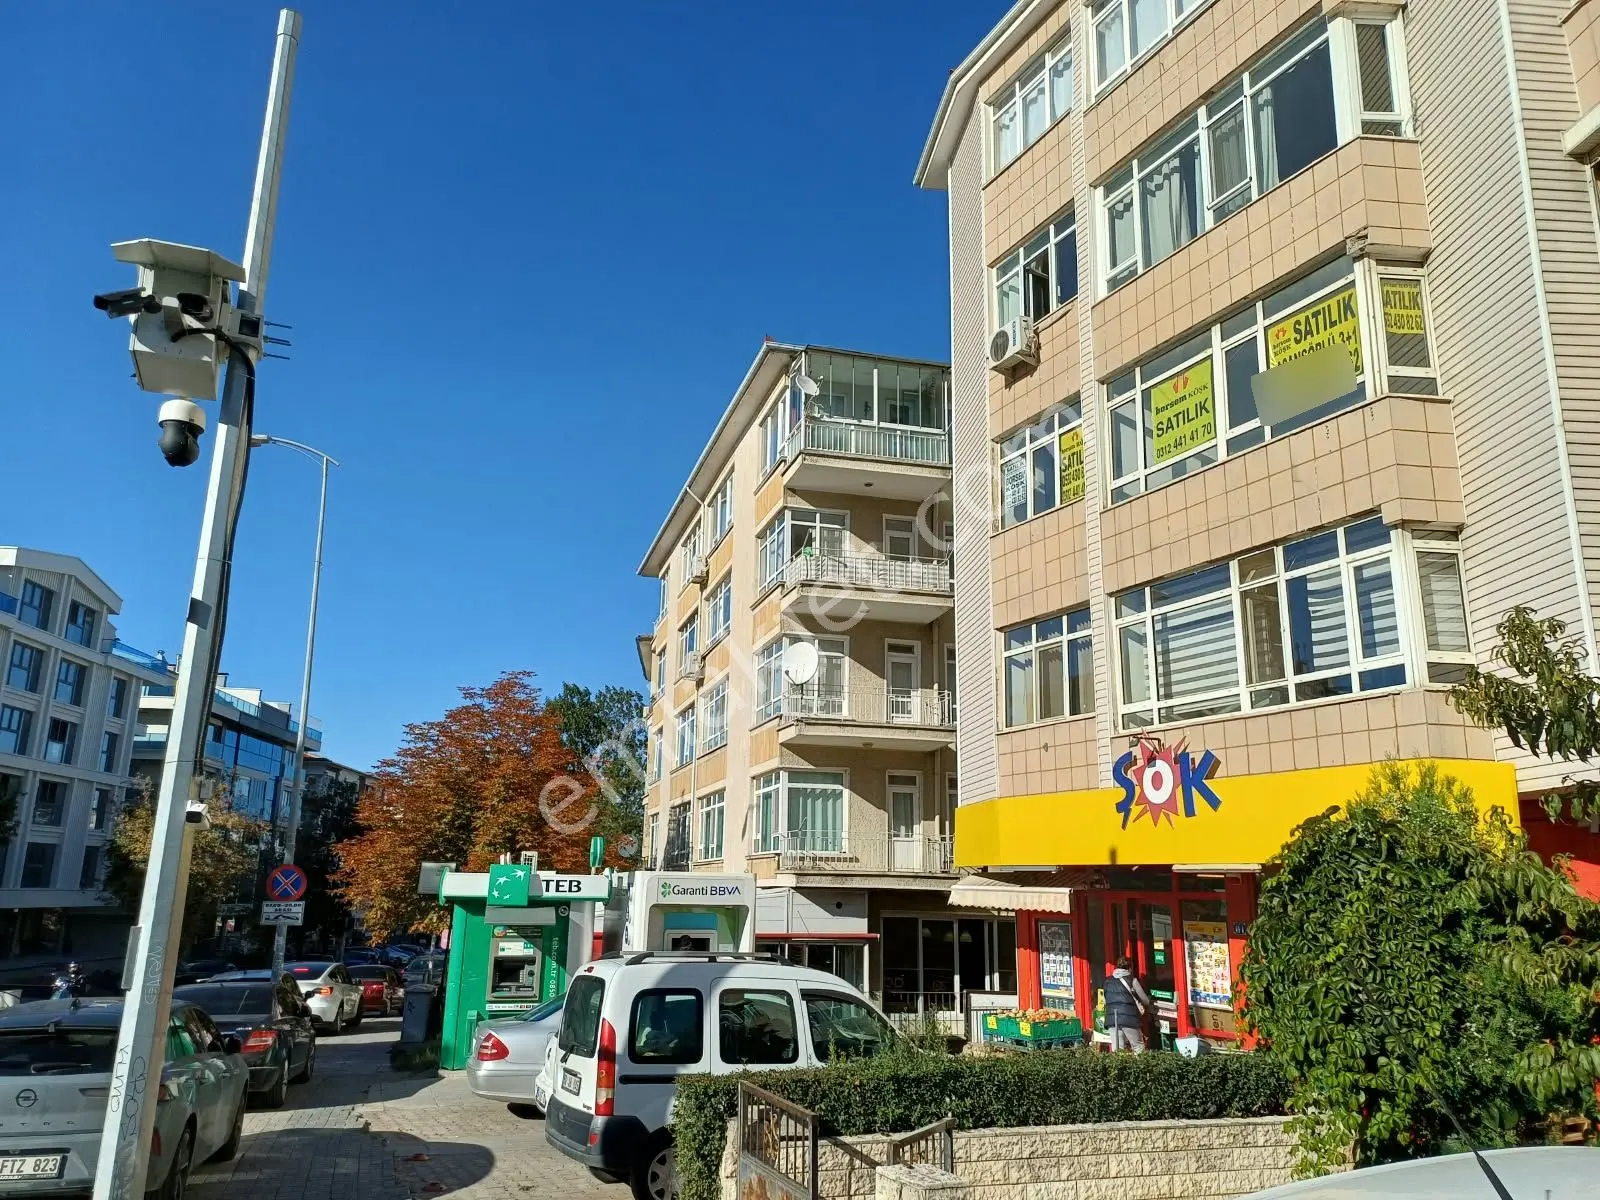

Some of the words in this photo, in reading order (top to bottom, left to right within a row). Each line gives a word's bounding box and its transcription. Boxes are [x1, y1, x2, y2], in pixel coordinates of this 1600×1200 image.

[1293, 291, 1356, 345] SATILIK
[1155, 394, 1187, 415] borsem
[1156, 397, 1210, 438] SATILIK
[1156, 444, 1172, 459] 0312
[1173, 434, 1187, 450] 441
[1189, 428, 1199, 442] 41
[1201, 422, 1212, 437] 70
[1112, 749, 1223, 831] ŞOK
[542, 879, 582, 894] TEB
[672, 884, 708, 897] Garanti
[710, 885, 742, 897] BBVA
[551, 937, 559, 978] teb.com.tr
[0, 1158, 26, 1174] FTZ
[32, 1158, 58, 1173] 823
